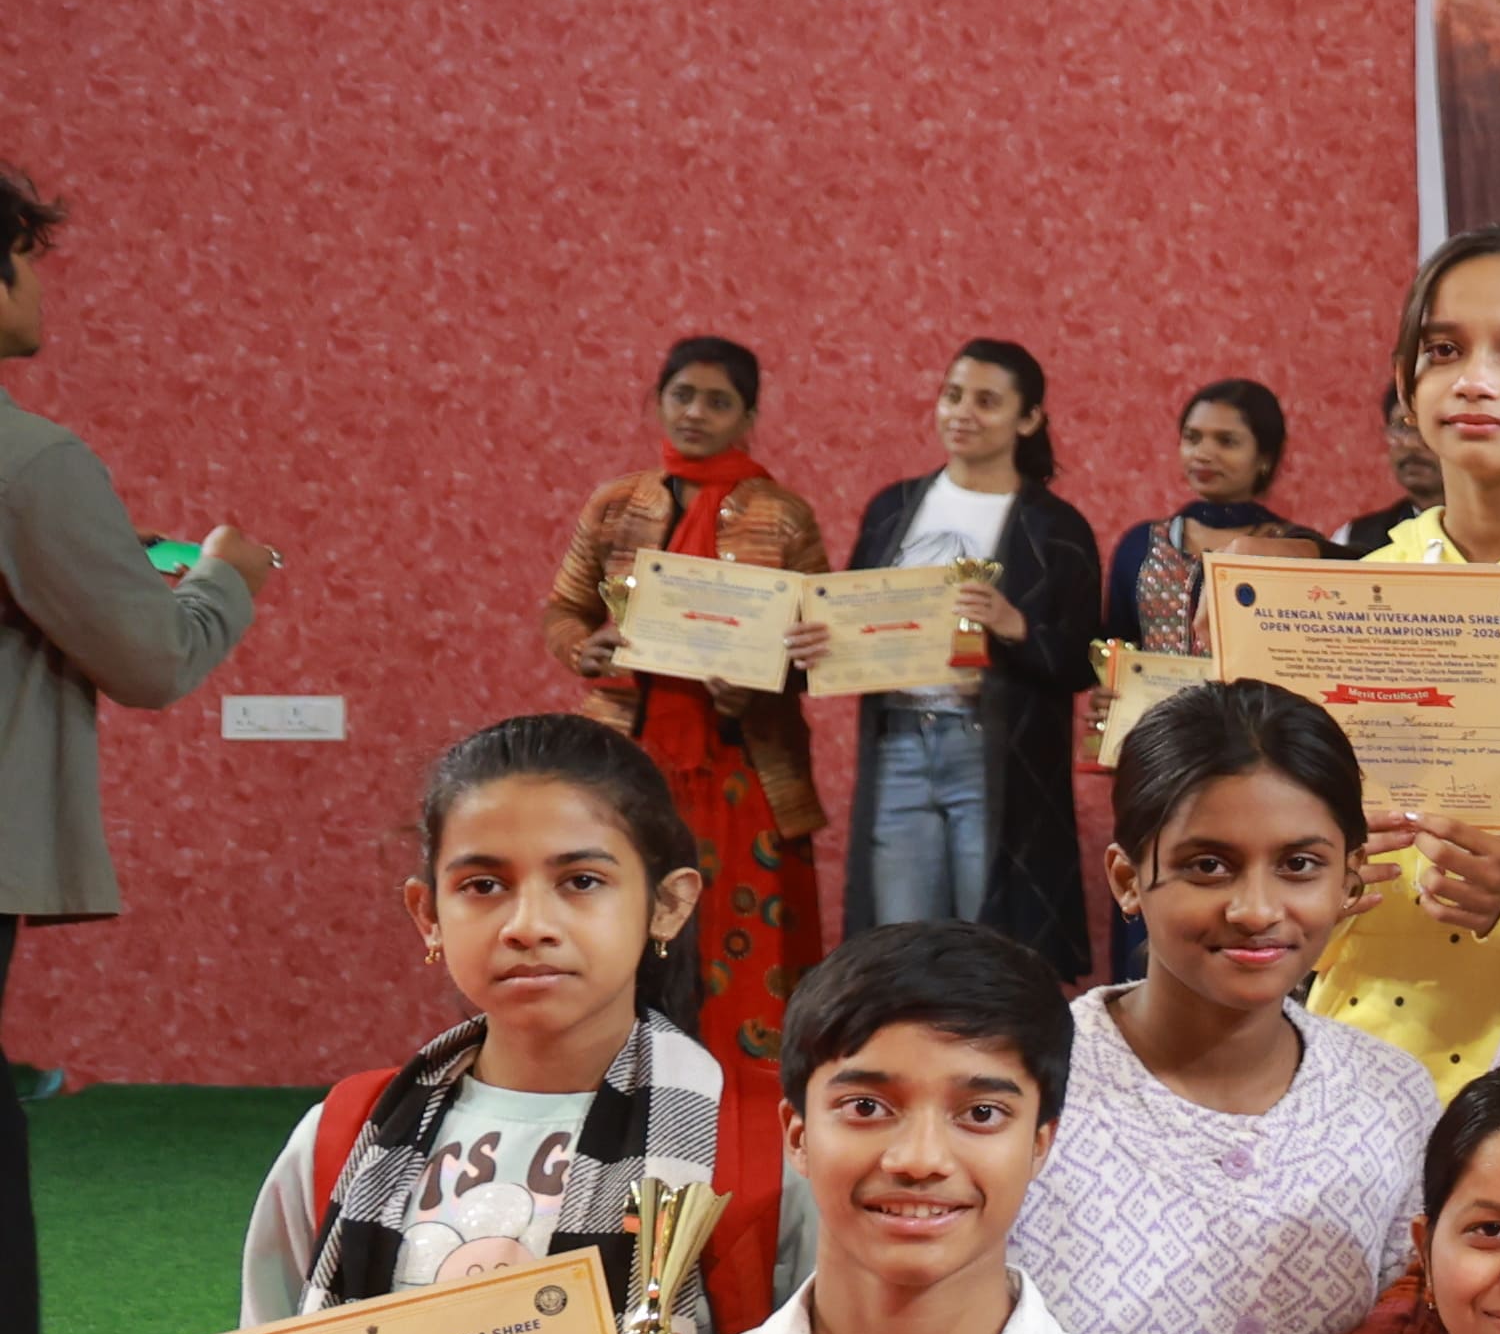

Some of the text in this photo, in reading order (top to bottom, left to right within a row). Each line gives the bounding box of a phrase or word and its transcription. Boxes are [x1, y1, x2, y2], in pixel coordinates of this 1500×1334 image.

[1253, 608, 1274, 617] ALL
[1276, 609, 1324, 620] BENGAL
[1326, 611, 1369, 621] SWAMI
[1375, 612, 1463, 624] VIVEKANANDA
[1259, 622, 1291, 631] OPEN
[1293, 623, 1363, 634] YOGASANA
[1367, 626, 1460, 638] CHAMPIONSHIP
